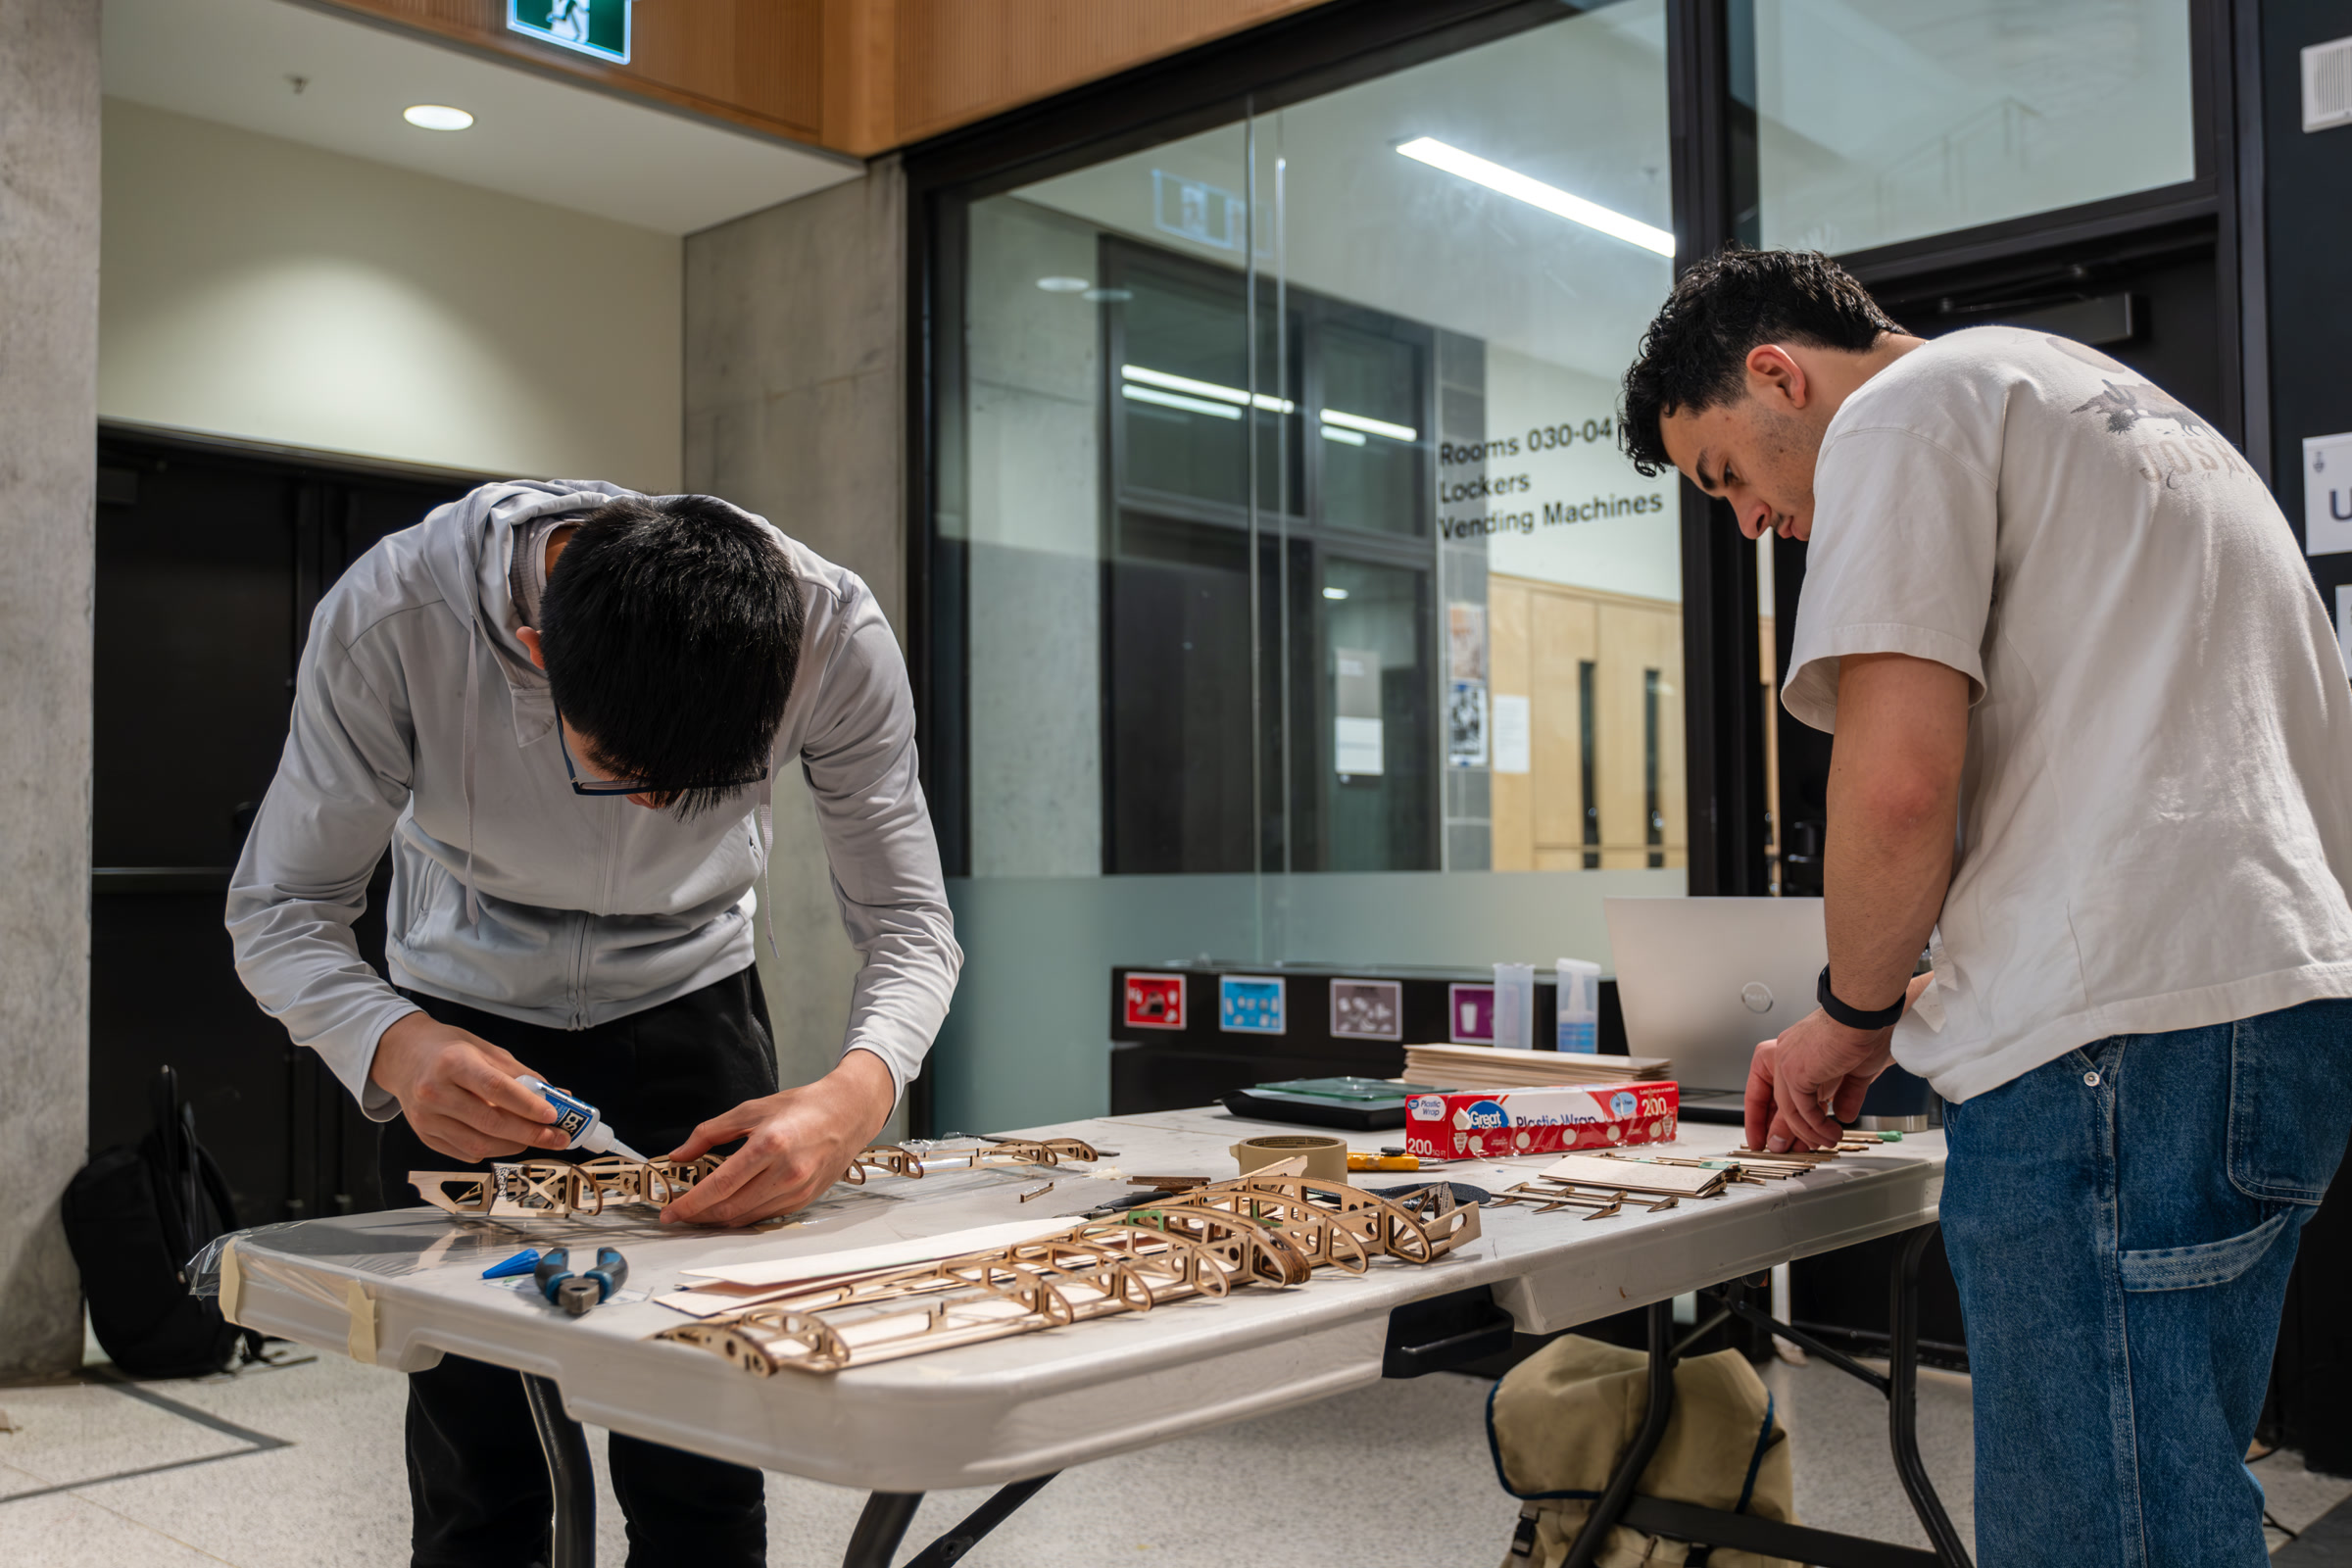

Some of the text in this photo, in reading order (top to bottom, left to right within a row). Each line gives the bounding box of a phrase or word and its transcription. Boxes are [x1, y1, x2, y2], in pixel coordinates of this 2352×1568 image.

[1440, 416, 1621, 466] Rooms 030-04
[2138, 438, 2245, 482] JOSH
[1440, 473, 1531, 504] Lockers
[1439, 493, 1663, 540] Vending Machines
[1422, 1108, 1440, 1117] Wrap
[1470, 1110, 1501, 1126] Great
[1642, 1097, 1667, 1117] 200
[1407, 1137, 1433, 1155] 200
